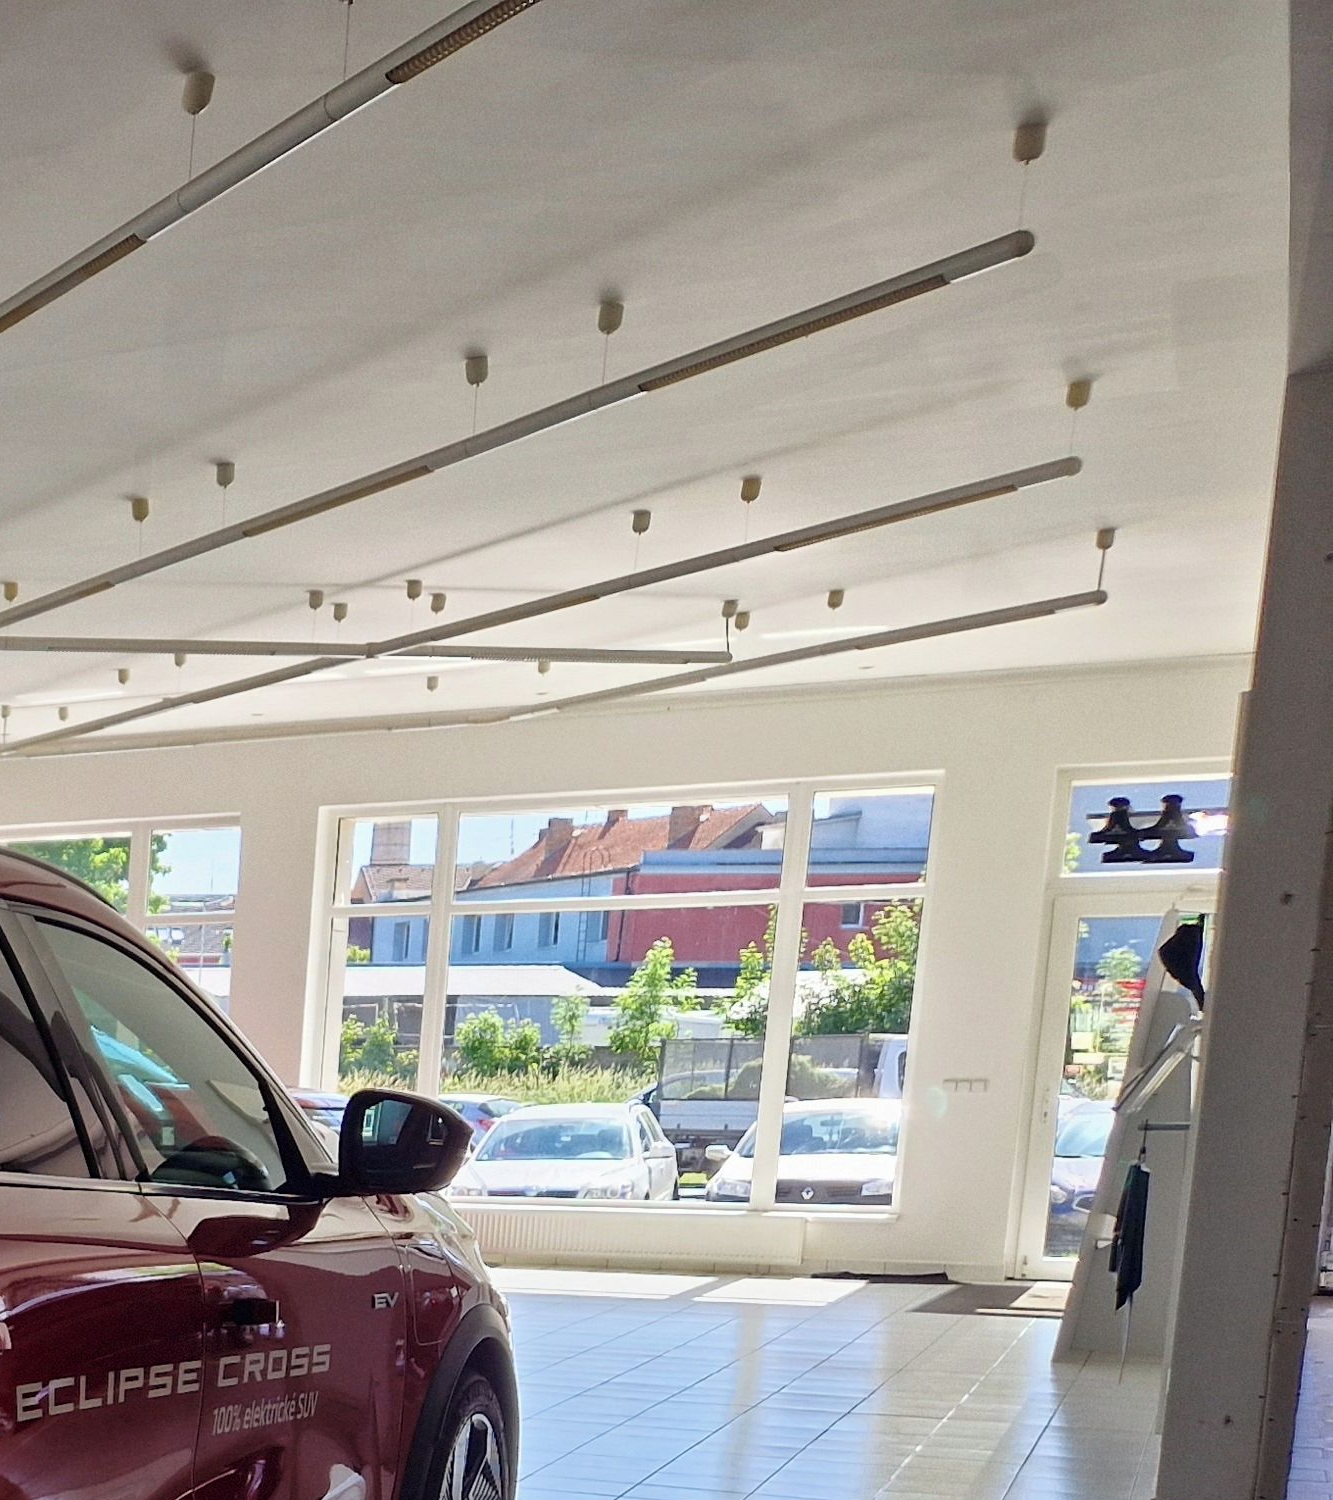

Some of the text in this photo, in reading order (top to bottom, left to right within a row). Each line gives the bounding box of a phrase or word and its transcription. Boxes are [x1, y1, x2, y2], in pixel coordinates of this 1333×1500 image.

[373, 1291, 399, 1310] EV
[15, 1344, 331, 1422] ECLIPSE CROSS
[212, 1391, 319, 1436] 100% elektrické SUV
